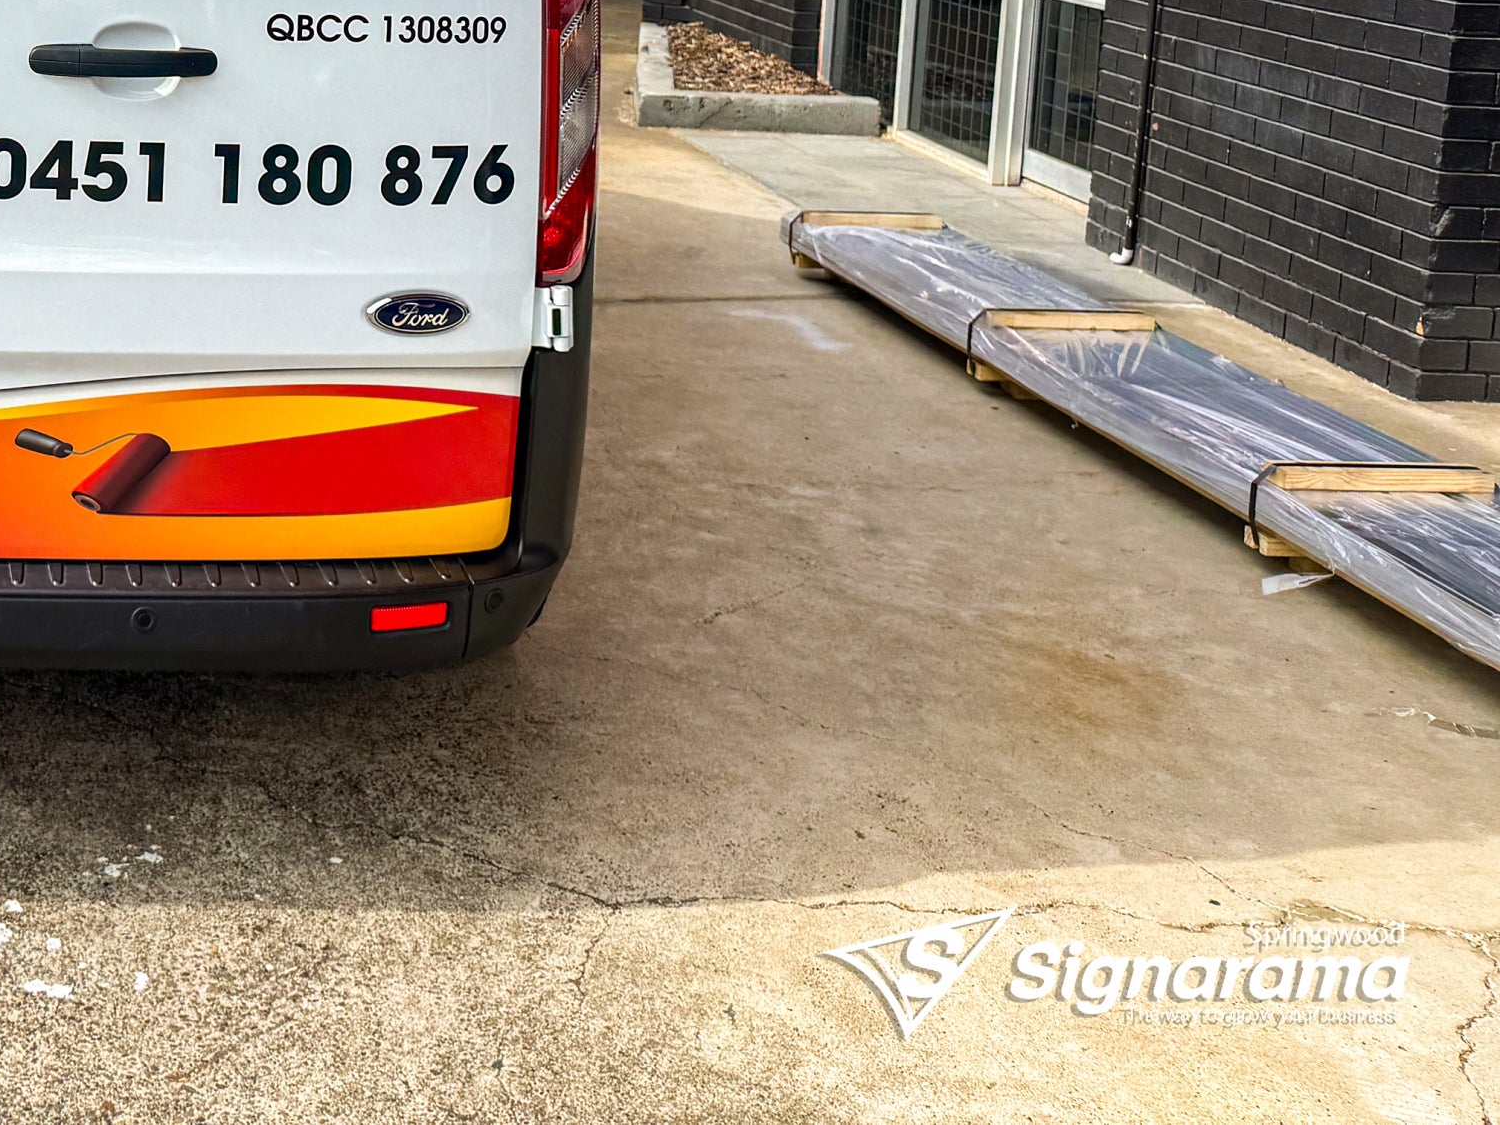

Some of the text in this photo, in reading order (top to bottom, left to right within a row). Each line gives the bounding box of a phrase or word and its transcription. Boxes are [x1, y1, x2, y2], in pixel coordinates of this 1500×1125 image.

[266, 13, 507, 44] QBCC 1308309
[214, 143, 353, 206] 180
[381, 144, 515, 206] 876
[391, 301, 450, 330] Ford
